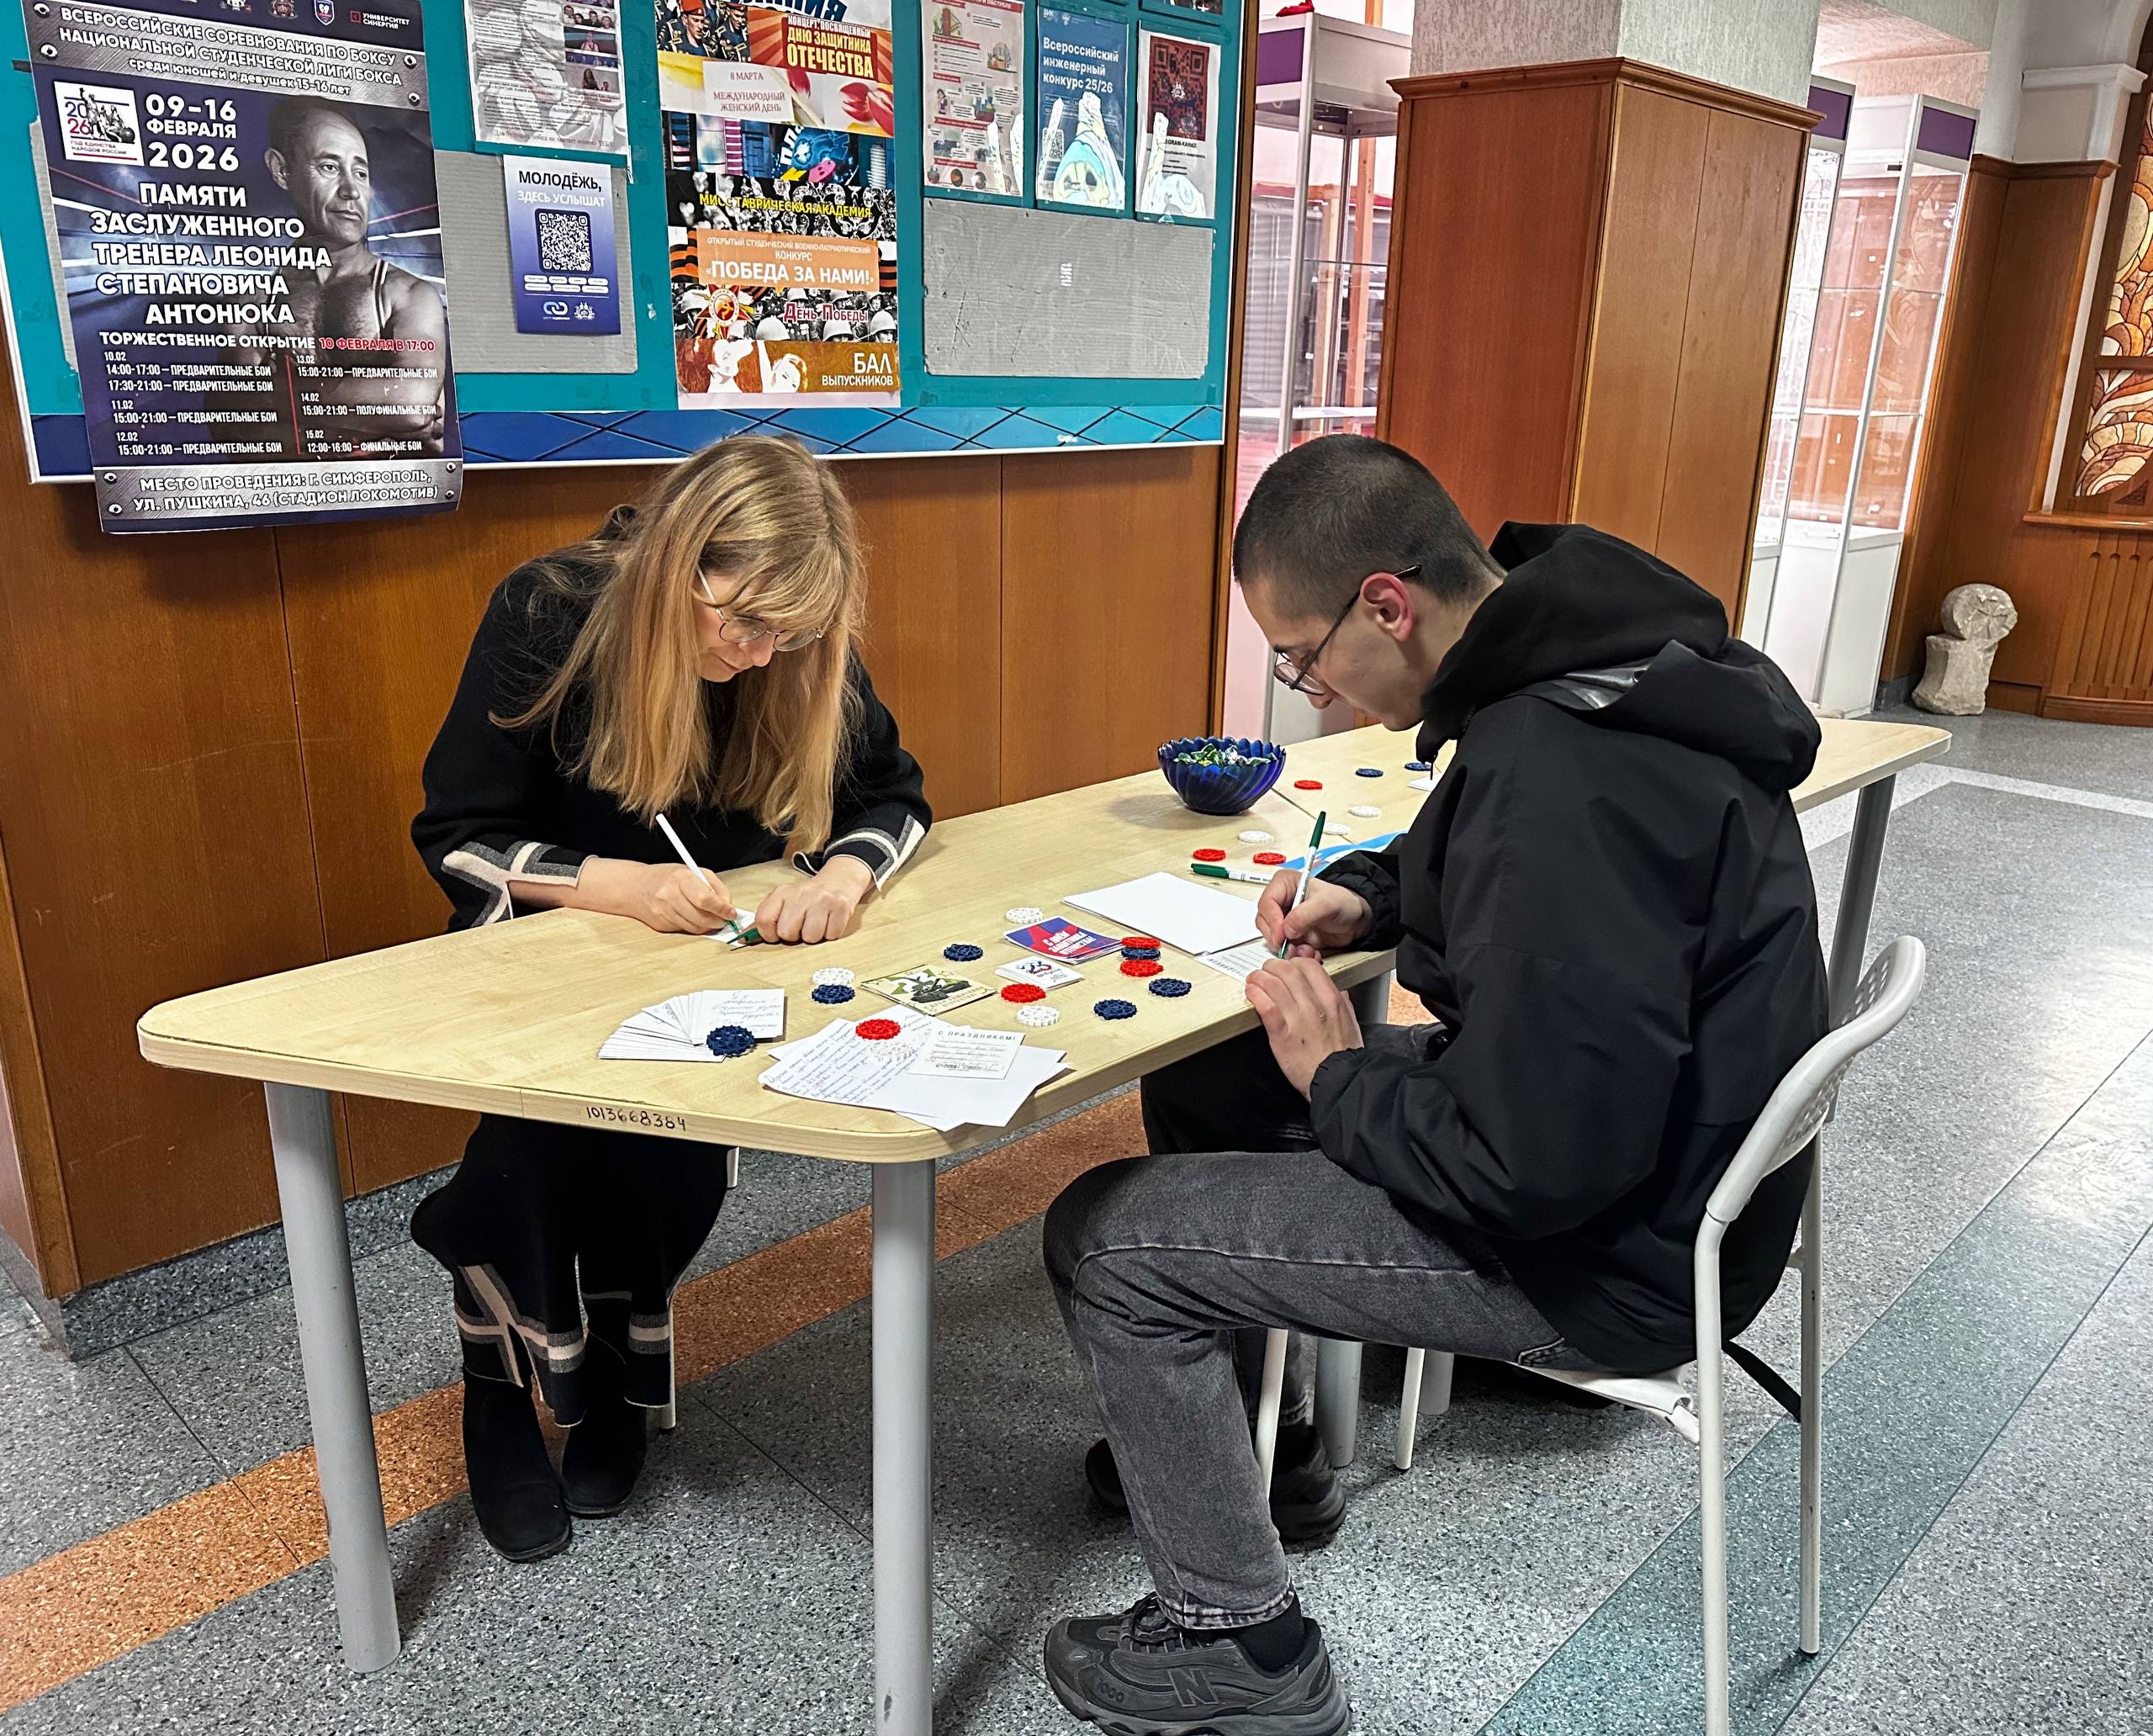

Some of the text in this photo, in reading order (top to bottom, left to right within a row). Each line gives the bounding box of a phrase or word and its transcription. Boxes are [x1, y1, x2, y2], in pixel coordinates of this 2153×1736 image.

[362, 13, 410, 25] УНИВЕРСИТЕТ
[362, 19, 399, 29] СИНЕРГИЯ
[60, 7, 397, 66] ВСЕРОССИЙСКИЕ СОРЕВНОВАНИЯ ПО БОКСУ
[787, 27, 872, 54] ДНЮ ЗАЩИТНИКА
[59, 27, 403, 86] НАЦИОНАЛЬНОЙ СТУДЕНЧЕСКОЙ ЛИГИ БОКСА
[1043, 37, 1119, 62] Всероссийский
[787, 43, 874, 78] ОТЕЧЕСТВА
[1043, 56, 1106, 77] инженерный
[129, 58, 351, 95] среди юношей и девушек 15-16 лет
[736, 72, 764, 81] МАРТА
[1043, 73, 1114, 93] конкурс 25/26
[713, 91, 786, 101] МЕЖДУНАРОДНЫЙ
[721, 103, 781, 113] ЖЕНСКИЙ ДЕНЬ
[145, 118, 236, 139] ФЕВРАЛЯ
[147, 141, 239, 172] 2026
[519, 171, 602, 192] МОЛОДЁЖЬ,
[140, 182, 246, 207] ПАМЯТИ
[517, 190, 606, 208] ЗДЕСЬ УСЛЫШАТ
[699, 193, 871, 218] МИСС ТАВРИЧЕСКАЯ АКАДЕМИЯ
[90, 211, 304, 238] ЗАСЛУЖЕННОГО
[707, 237, 870, 253] ОТКРЫТЫЙ СТУДЕНЧЕСКИЙ ВОЕННО-ПАТРИОТИЧЕСКИЙ
[92, 242, 333, 270] ТРЕНЕРА ЛЕОНИДА
[775, 251, 812, 261] КОНКУРС
[794, 266, 815, 283] ЗА
[96, 273, 289, 295] СТЕПАНОВИЧА
[145, 302, 295, 326] АНТОНЮКА
[99, 331, 435, 351] ТОРЖЕСТВЕННОЕ ОТКРЫТИЕ 10 ФЕВРАЛЯ В 17:00
[103, 352, 126, 362] 10.02
[296, 355, 315, 364] 13.02
[854, 352, 892, 373] БАЛ
[171, 364, 254, 377] ПРЕДВАРИТЕЛЬНЫЕ
[255, 365, 272, 376] БОИ
[352, 367, 423, 378] ПРЕДВАРИТЕЛЬНЫЕ
[424, 368, 437, 378] БОИ
[172, 380, 256, 392] ПРЕДВАРИТЕЛЬНЫЕ
[257, 381, 273, 392] БОИ
[822, 374, 893, 386] ВЫПУСКНИКОВ
[111, 400, 134, 410] 11.02
[301, 393, 320, 402] 14.02
[177, 411, 260, 424] ПРЕДВАРИТЕЛЬНЫЕ
[261, 411, 278, 422] БОИ
[356, 405, 421, 415] ПОЛУФИНАЛЬНЫЕ
[422, 405, 436, 415] БОИ
[116, 431, 139, 442] 12.02
[305, 430, 324, 439] 15.02
[183, 443, 265, 455] ПРЕДВАРИТЕЛЬНЫЕ
[266, 442, 283, 453] БОИ
[360, 442, 406, 452] ФИНАЛЬНЫЕ
[407, 442, 422, 451] БОИ
[140, 470, 432, 491] МЕСТО ПРОВЕДЕНИЯ: Г. СИМФЕРОПОЛЬ,
[133, 485, 438, 511] УЛ. ПУШКИНА, 46 (СТАДИОН ЛОКОМОТИВ)
[586, 1106, 685, 1131] 1013668384
